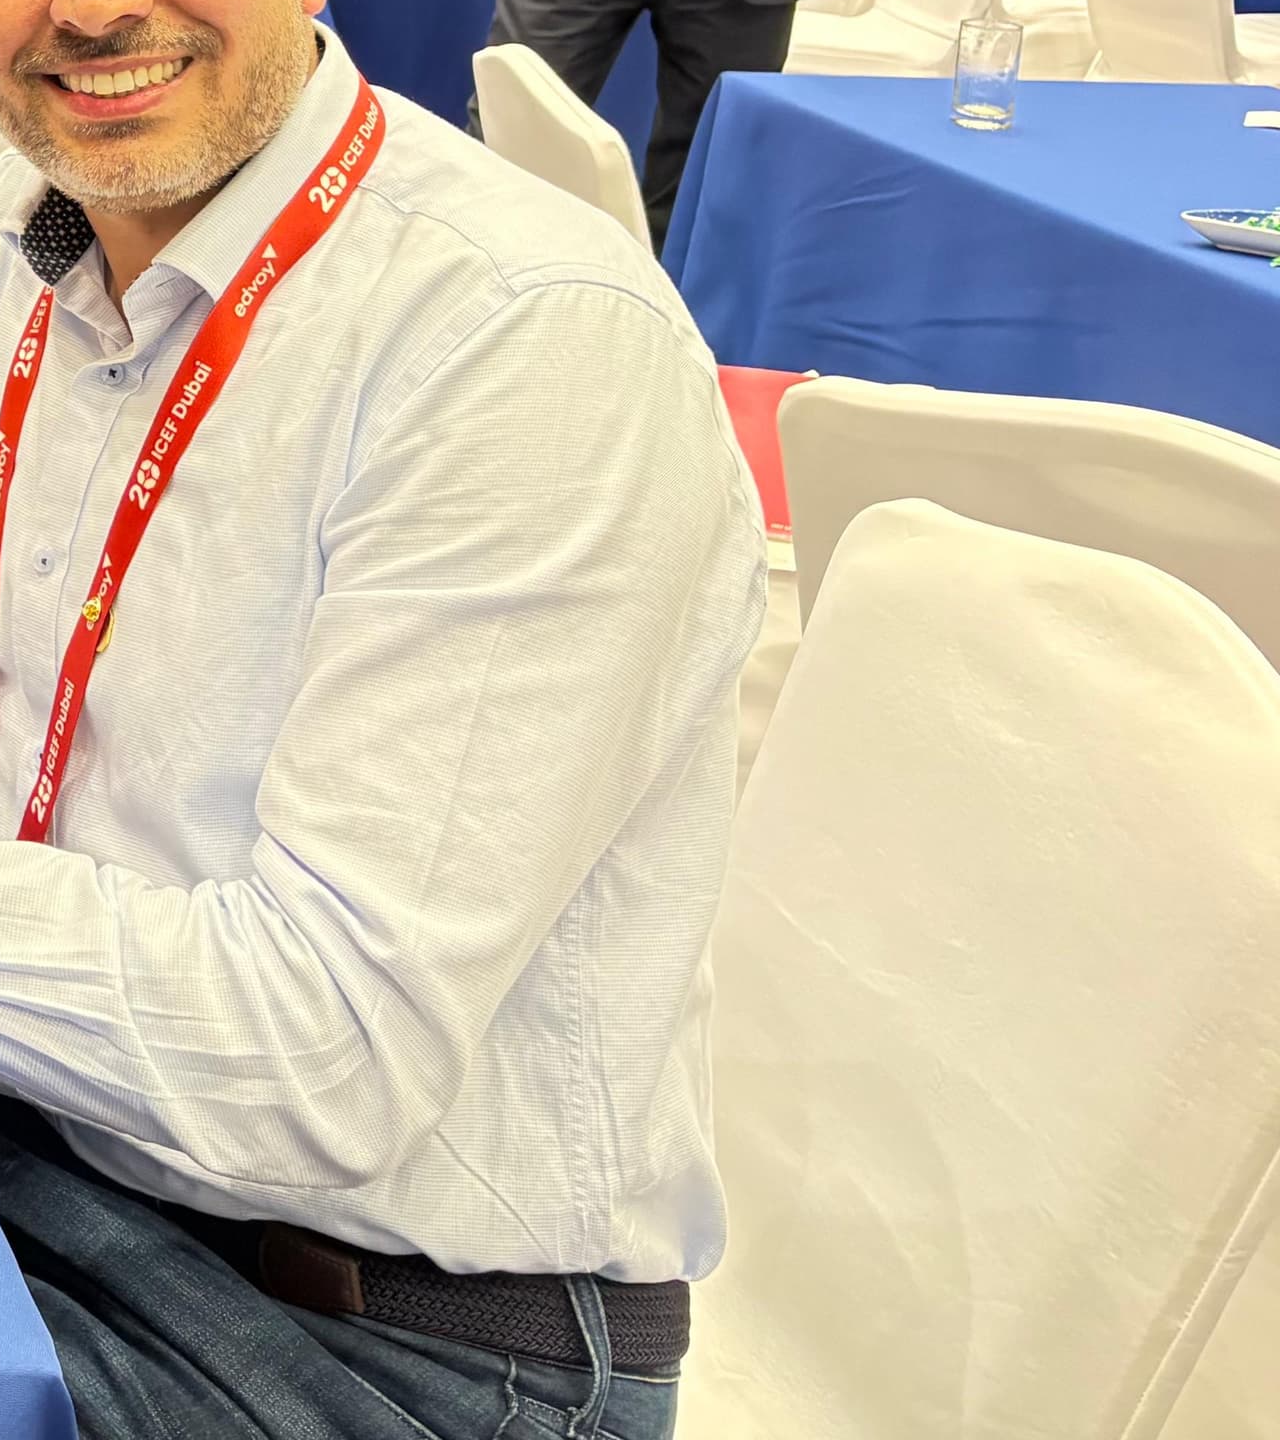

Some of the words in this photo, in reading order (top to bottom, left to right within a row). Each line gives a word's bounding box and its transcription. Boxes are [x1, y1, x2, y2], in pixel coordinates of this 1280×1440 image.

[339, 137, 365, 173] ICEF
[234, 261, 278, 318] edvoy
[151, 416, 179, 461] ICEF
[171, 360, 213, 420] Dubai
[86, 569, 114, 632] evoy
[46, 734, 62, 777] ICEF
[55, 677, 76, 737] Dubai
